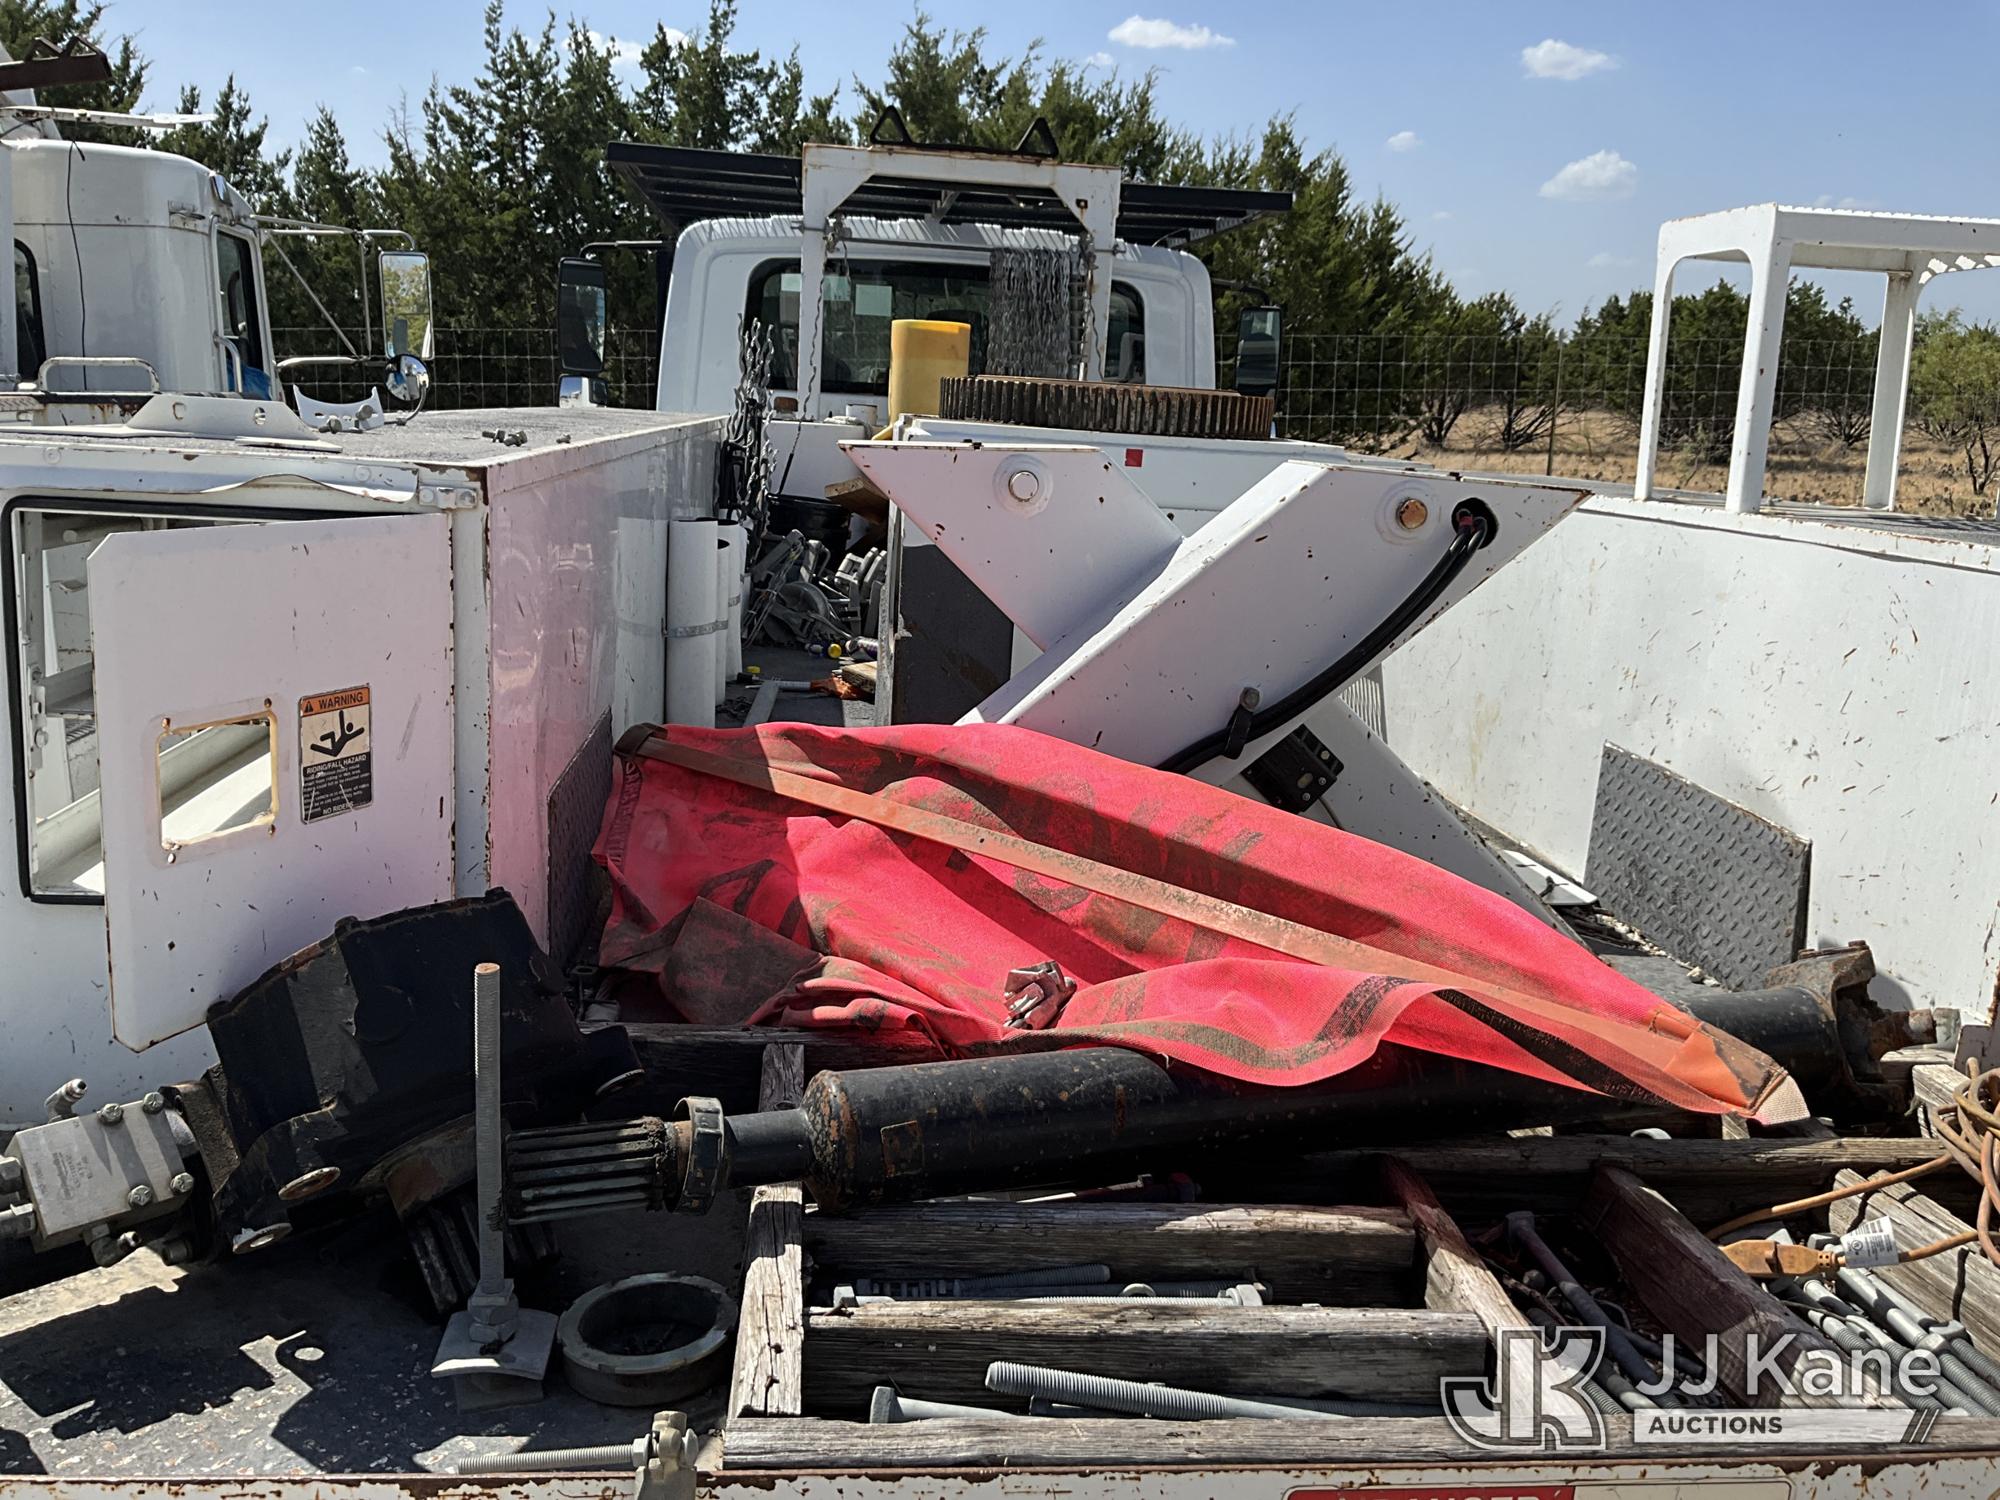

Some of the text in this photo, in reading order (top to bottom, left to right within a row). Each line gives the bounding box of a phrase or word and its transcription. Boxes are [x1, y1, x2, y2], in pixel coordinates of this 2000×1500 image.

[318, 691, 364, 710] WARNING
[306, 754, 367, 775] RIDING/FALL HAZARD
[322, 807, 332, 815] NO
